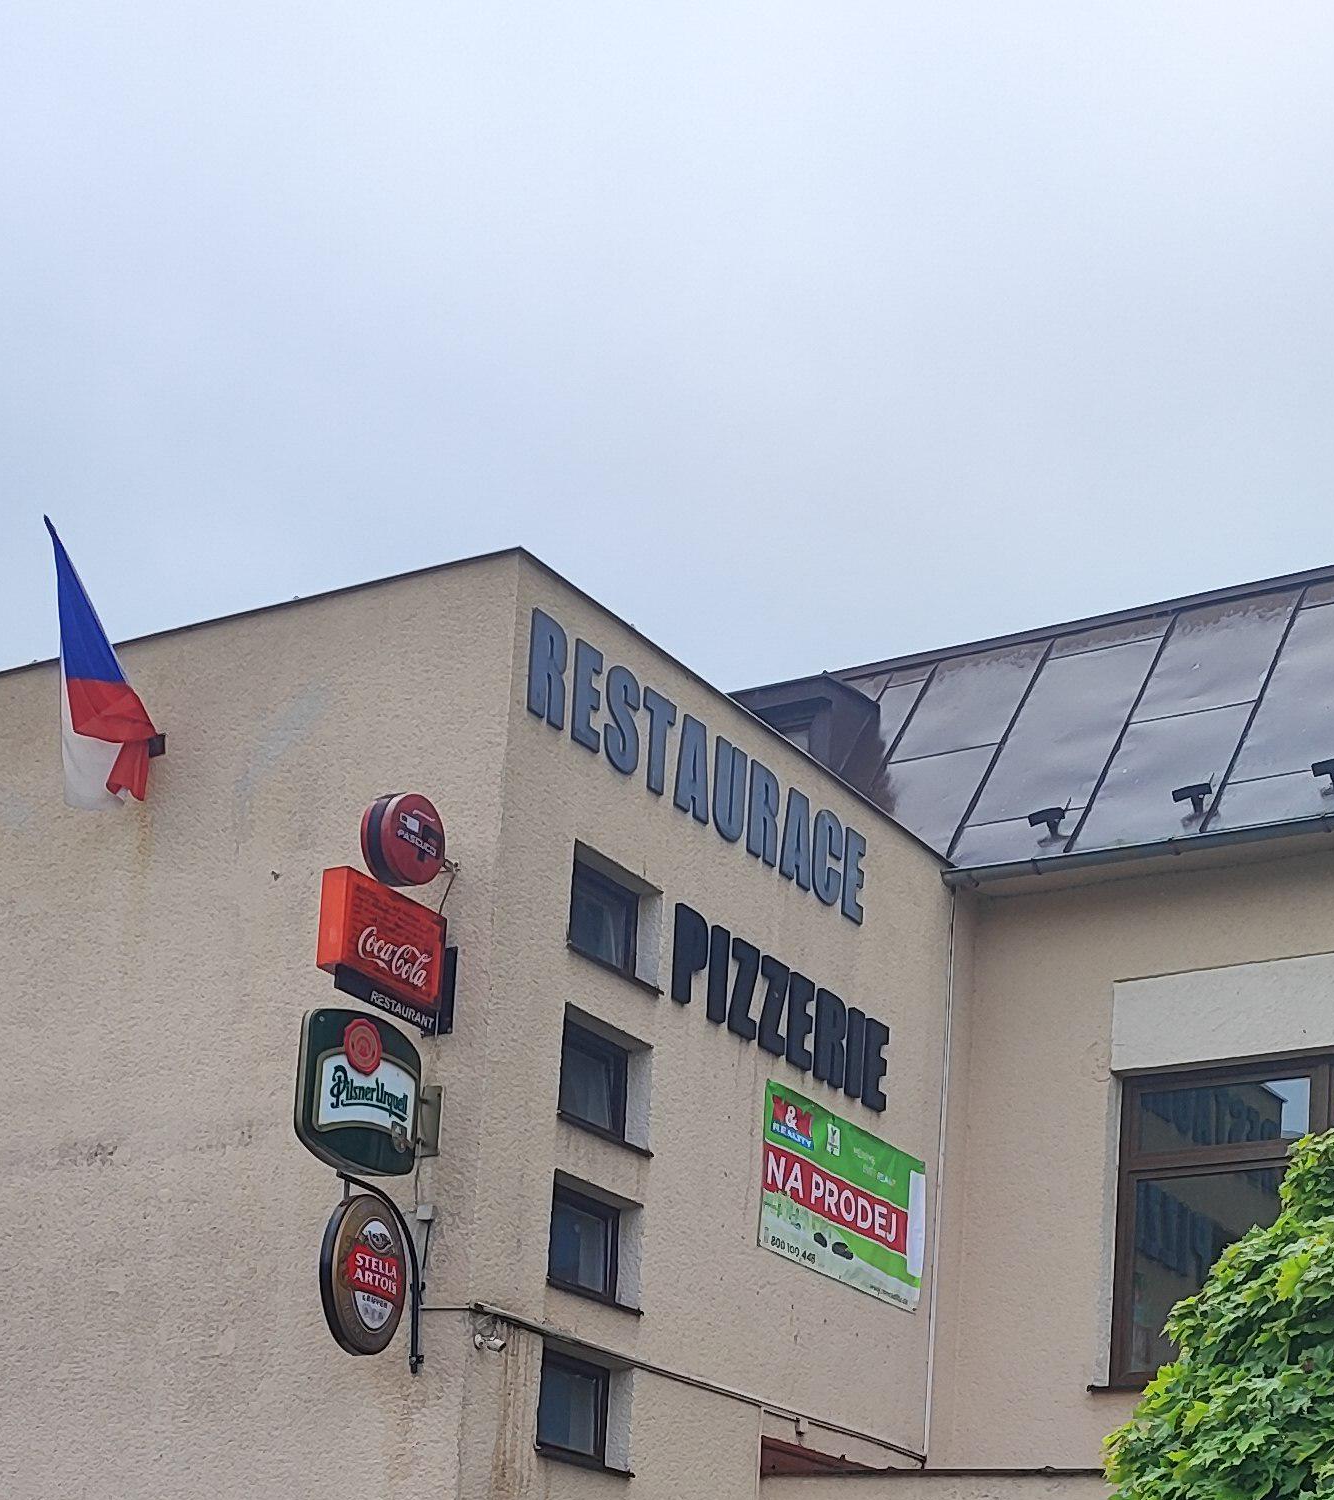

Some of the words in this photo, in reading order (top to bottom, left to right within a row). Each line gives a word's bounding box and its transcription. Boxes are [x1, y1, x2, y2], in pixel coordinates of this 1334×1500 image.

[527, 607, 867, 925] RESTAURACE
[370, 990, 435, 1030] RESTAURANT
[670, 902, 890, 1112] PIZZERIE
[329, 1065, 377, 1109] Pilsner
[375, 1077, 409, 1118] Urquell
[767, 1151, 804, 1199] NA
[810, 1172, 897, 1243] PRODEJ
[353, 1267, 397, 1296] ARTOIS
[354, 1252, 397, 1280] STELLA
